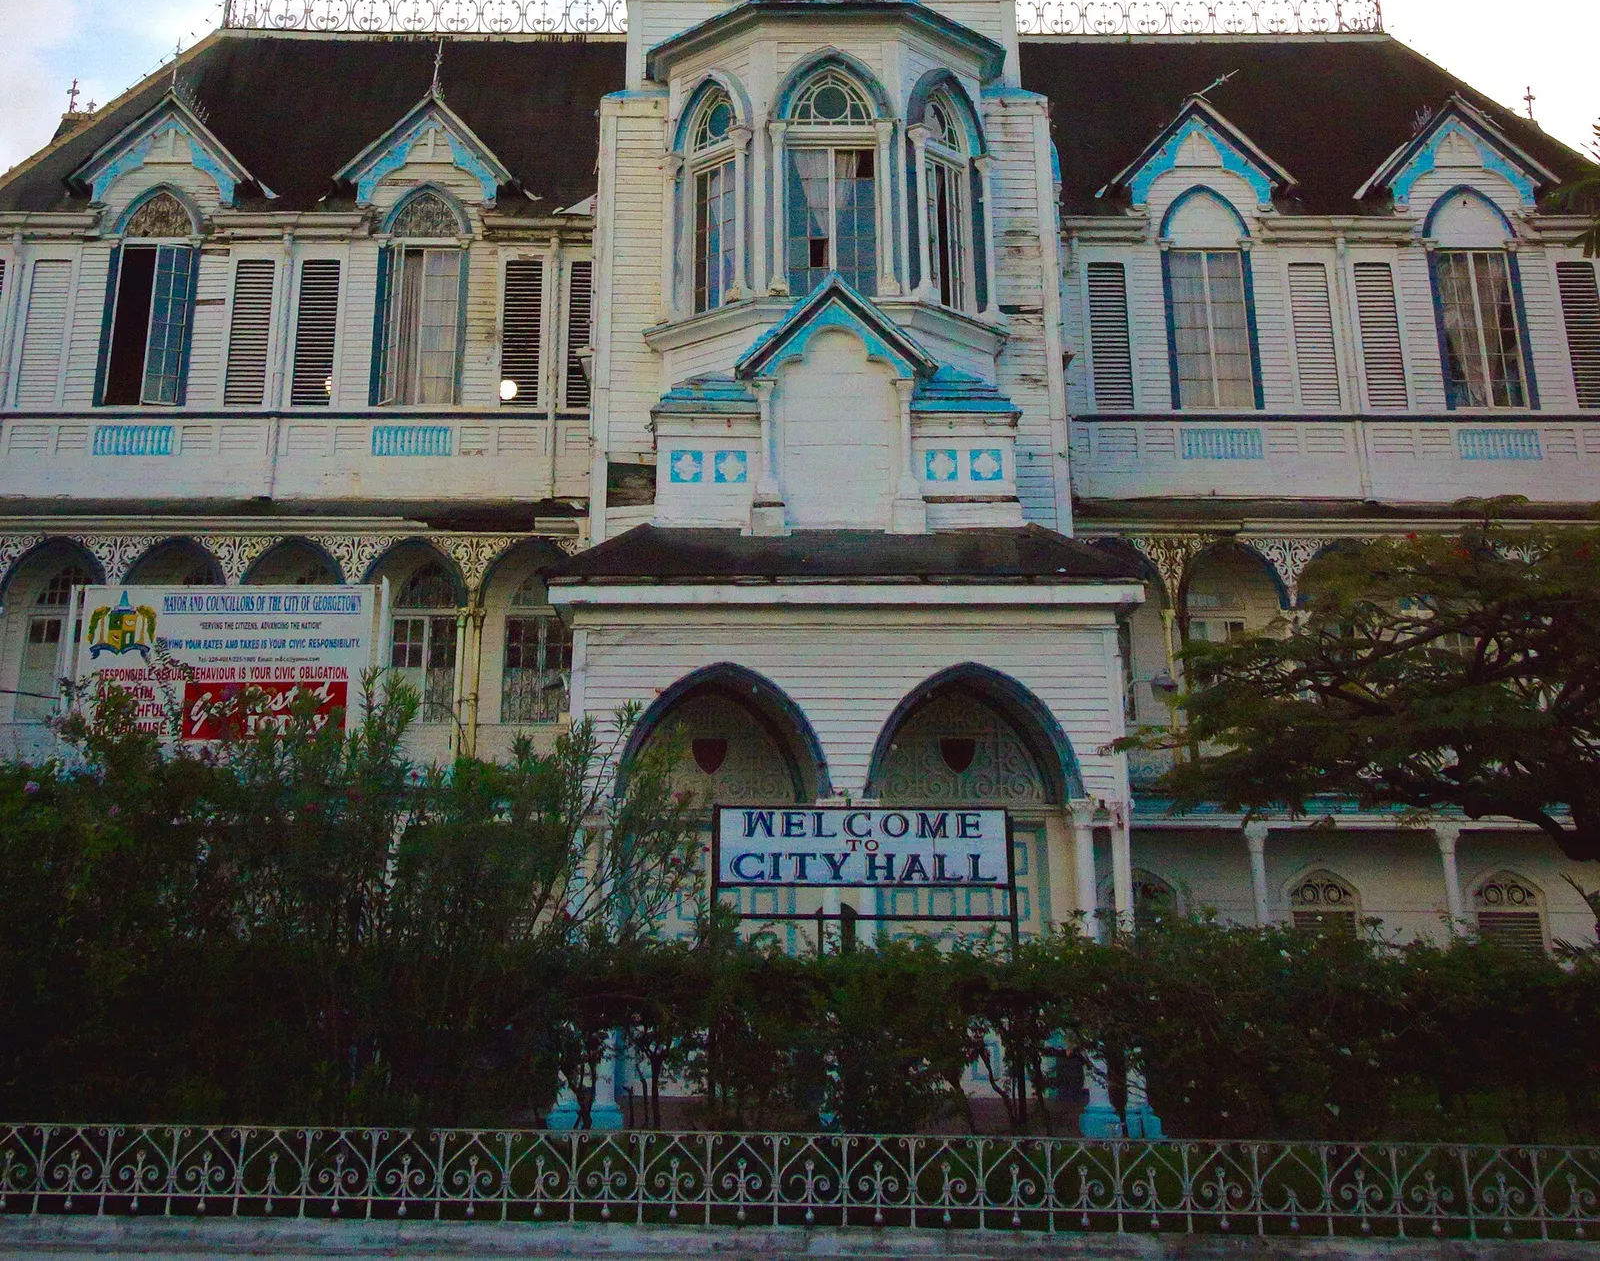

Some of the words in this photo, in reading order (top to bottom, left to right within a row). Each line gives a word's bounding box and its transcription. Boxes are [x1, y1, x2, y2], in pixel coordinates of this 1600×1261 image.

[163, 596, 187, 611] MAYOR
[190, 596, 204, 611] AND
[206, 595, 255, 611] COUNCILLORS
[256, 595, 266, 611] OF
[269, 595, 282, 611] THE
[284, 595, 299, 611] CITY
[301, 595, 310, 611] OF
[312, 595, 361, 611] GEORGETOWN
[224, 622, 234, 630] THE
[260, 622, 289, 630] ADVANCING
[290, 622, 300, 630] THE
[185, 639, 202, 650] YOUR
[203, 639, 223, 650] RATES
[225, 639, 239, 650] AND
[240, 639, 260, 650] TAXES
[261, 639, 267, 649] IS
[269, 639, 286, 649] YOUR
[288, 639, 307, 649] CIVIC
[99, 668, 153, 681] RESPONSIBLE
[238, 667, 246, 679] IS
[249, 666, 271, 679] YOUR
[274, 666, 296, 679] CIVIC
[299, 666, 349, 679] OBLIGATION.
[742, 811, 982, 838] WELCOME
[846, 839, 879, 852] TO
[730, 852, 850, 882] CITY
[864, 853, 998, 882] HALL
